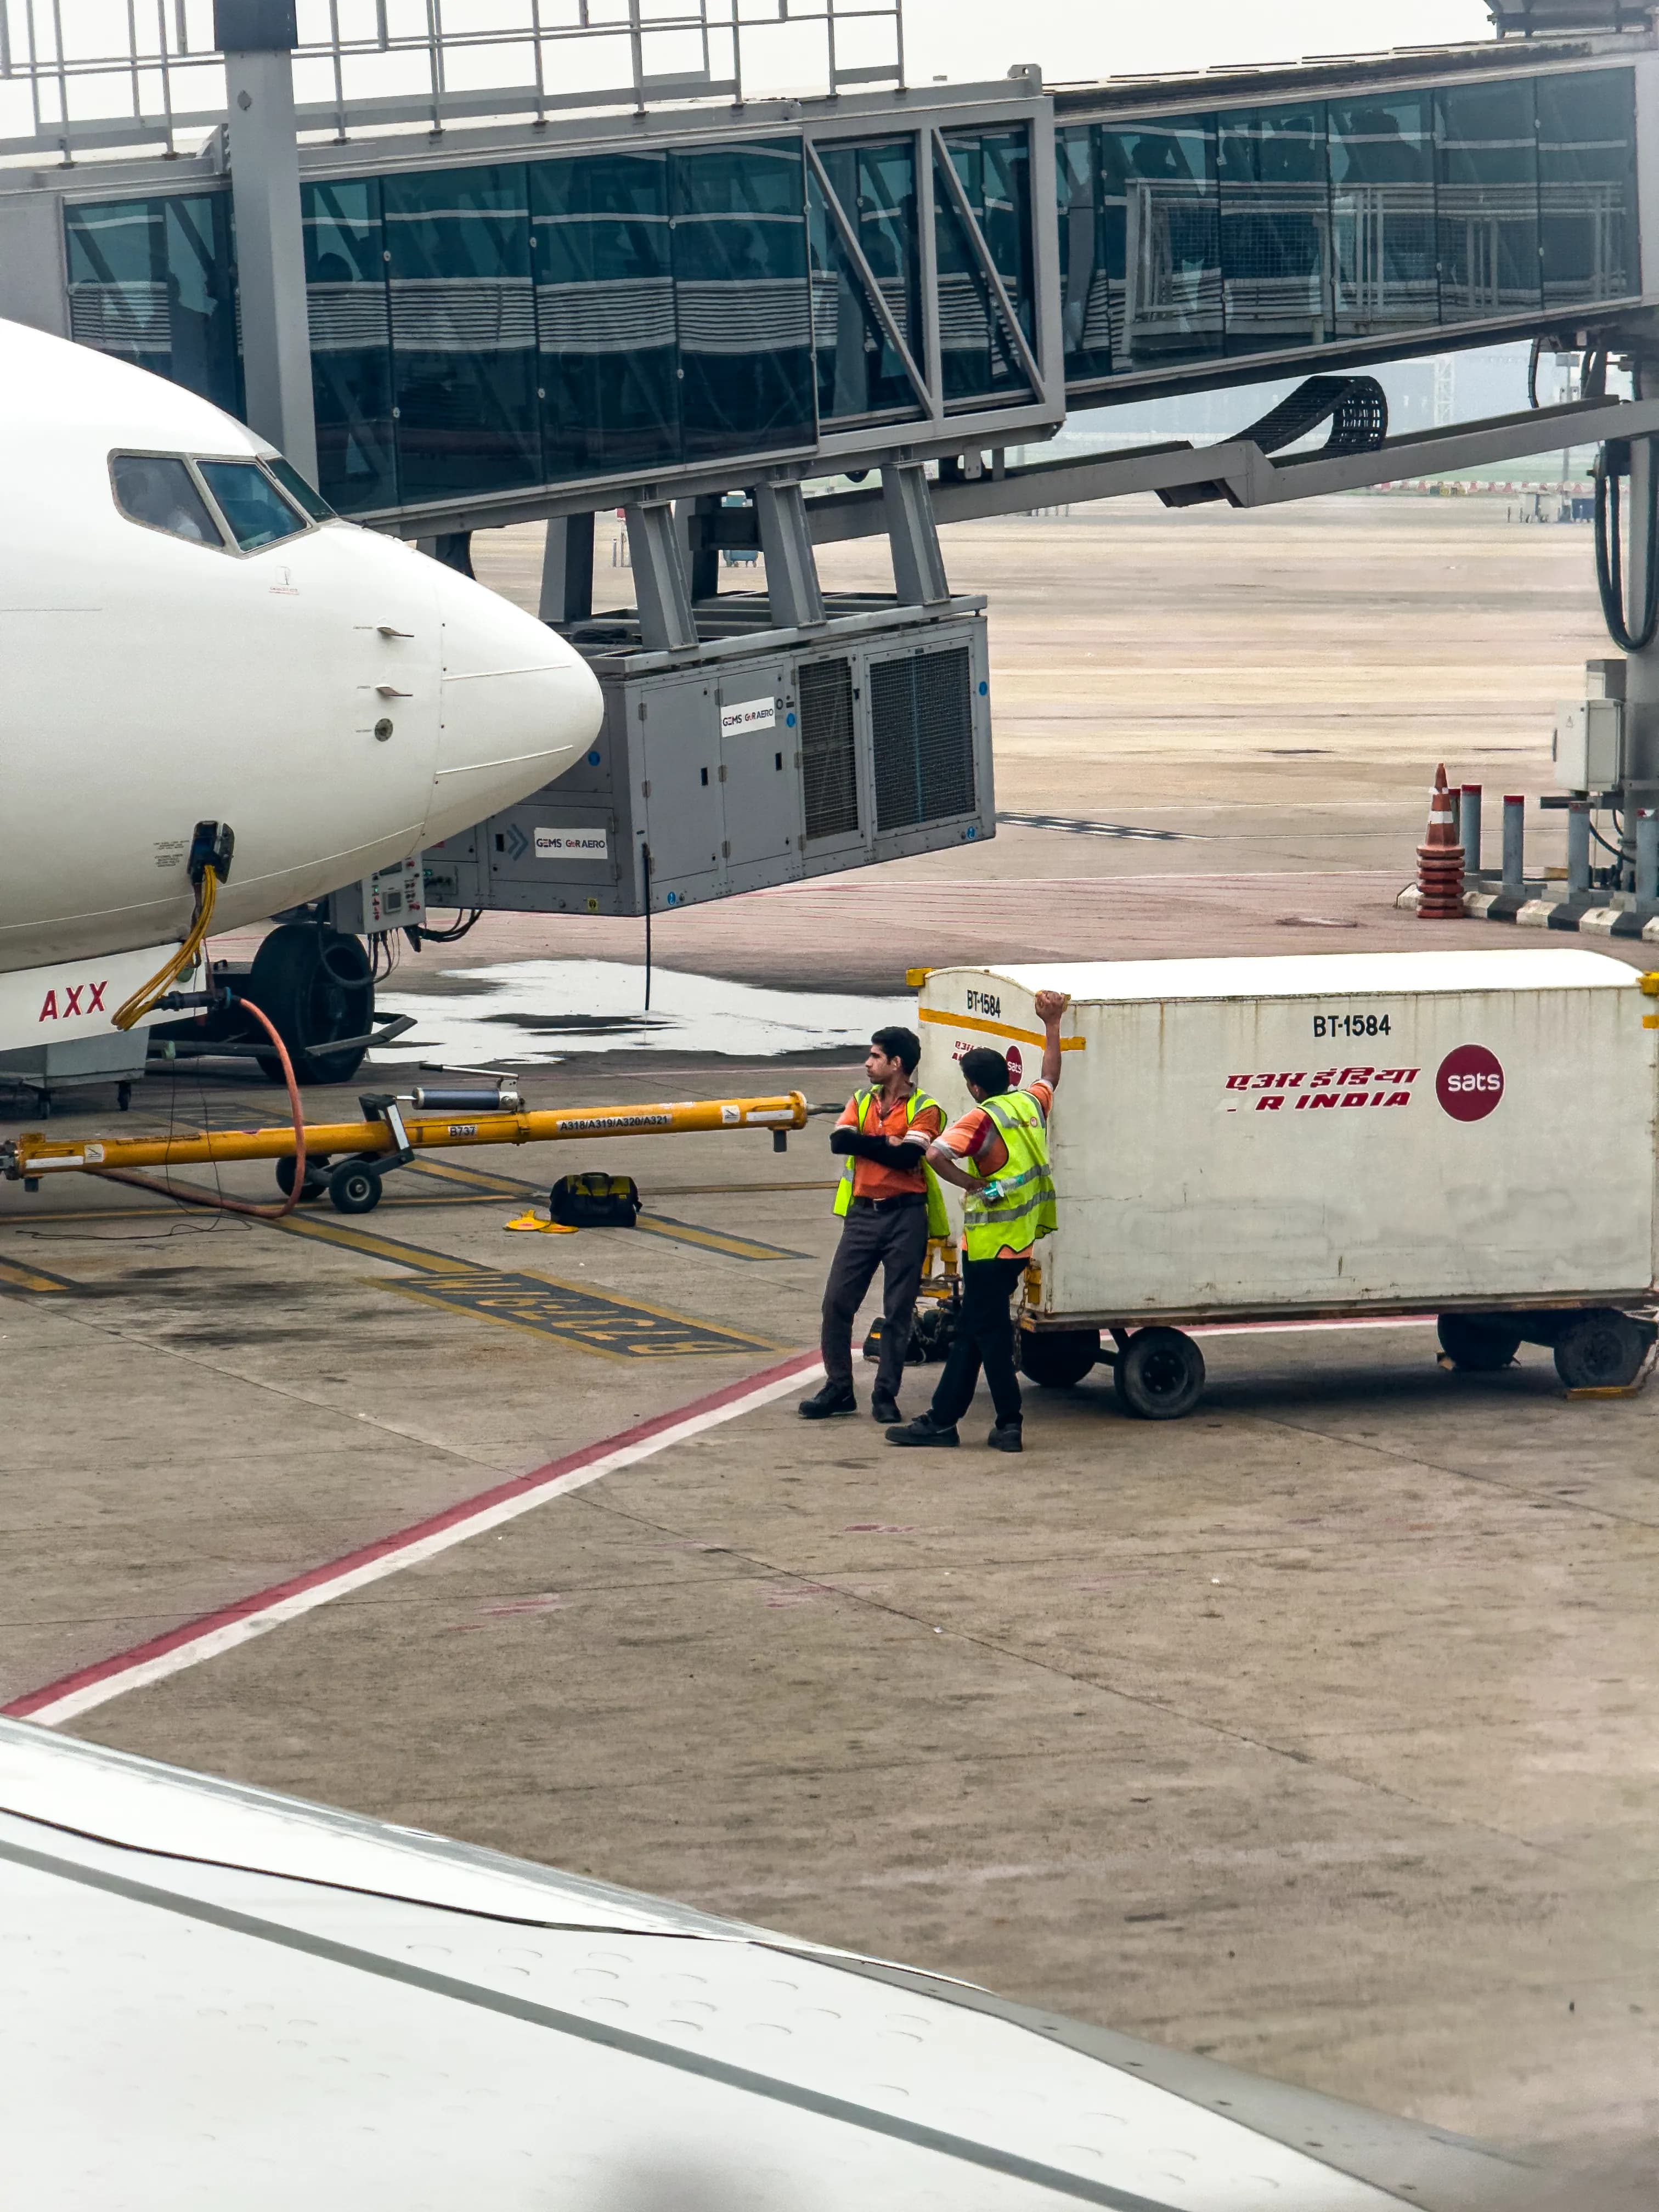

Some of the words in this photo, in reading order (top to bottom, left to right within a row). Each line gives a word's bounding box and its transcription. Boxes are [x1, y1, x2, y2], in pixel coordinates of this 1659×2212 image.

[723, 714, 742, 726] GEMS
[537, 838, 562, 848] GEMS
[38, 980, 108, 1022] AXX
[967, 989, 1001, 1018] BT-1584
[1313, 1014, 1391, 1037] BT-1584
[1007, 1062, 1022, 1074] sats
[1447, 1073, 1501, 1092] sats
[1295, 1092, 1410, 1109] INDIA
[560, 1115, 668, 1131] A318/A319/A320/A321
[449, 1126, 476, 1137] B737
